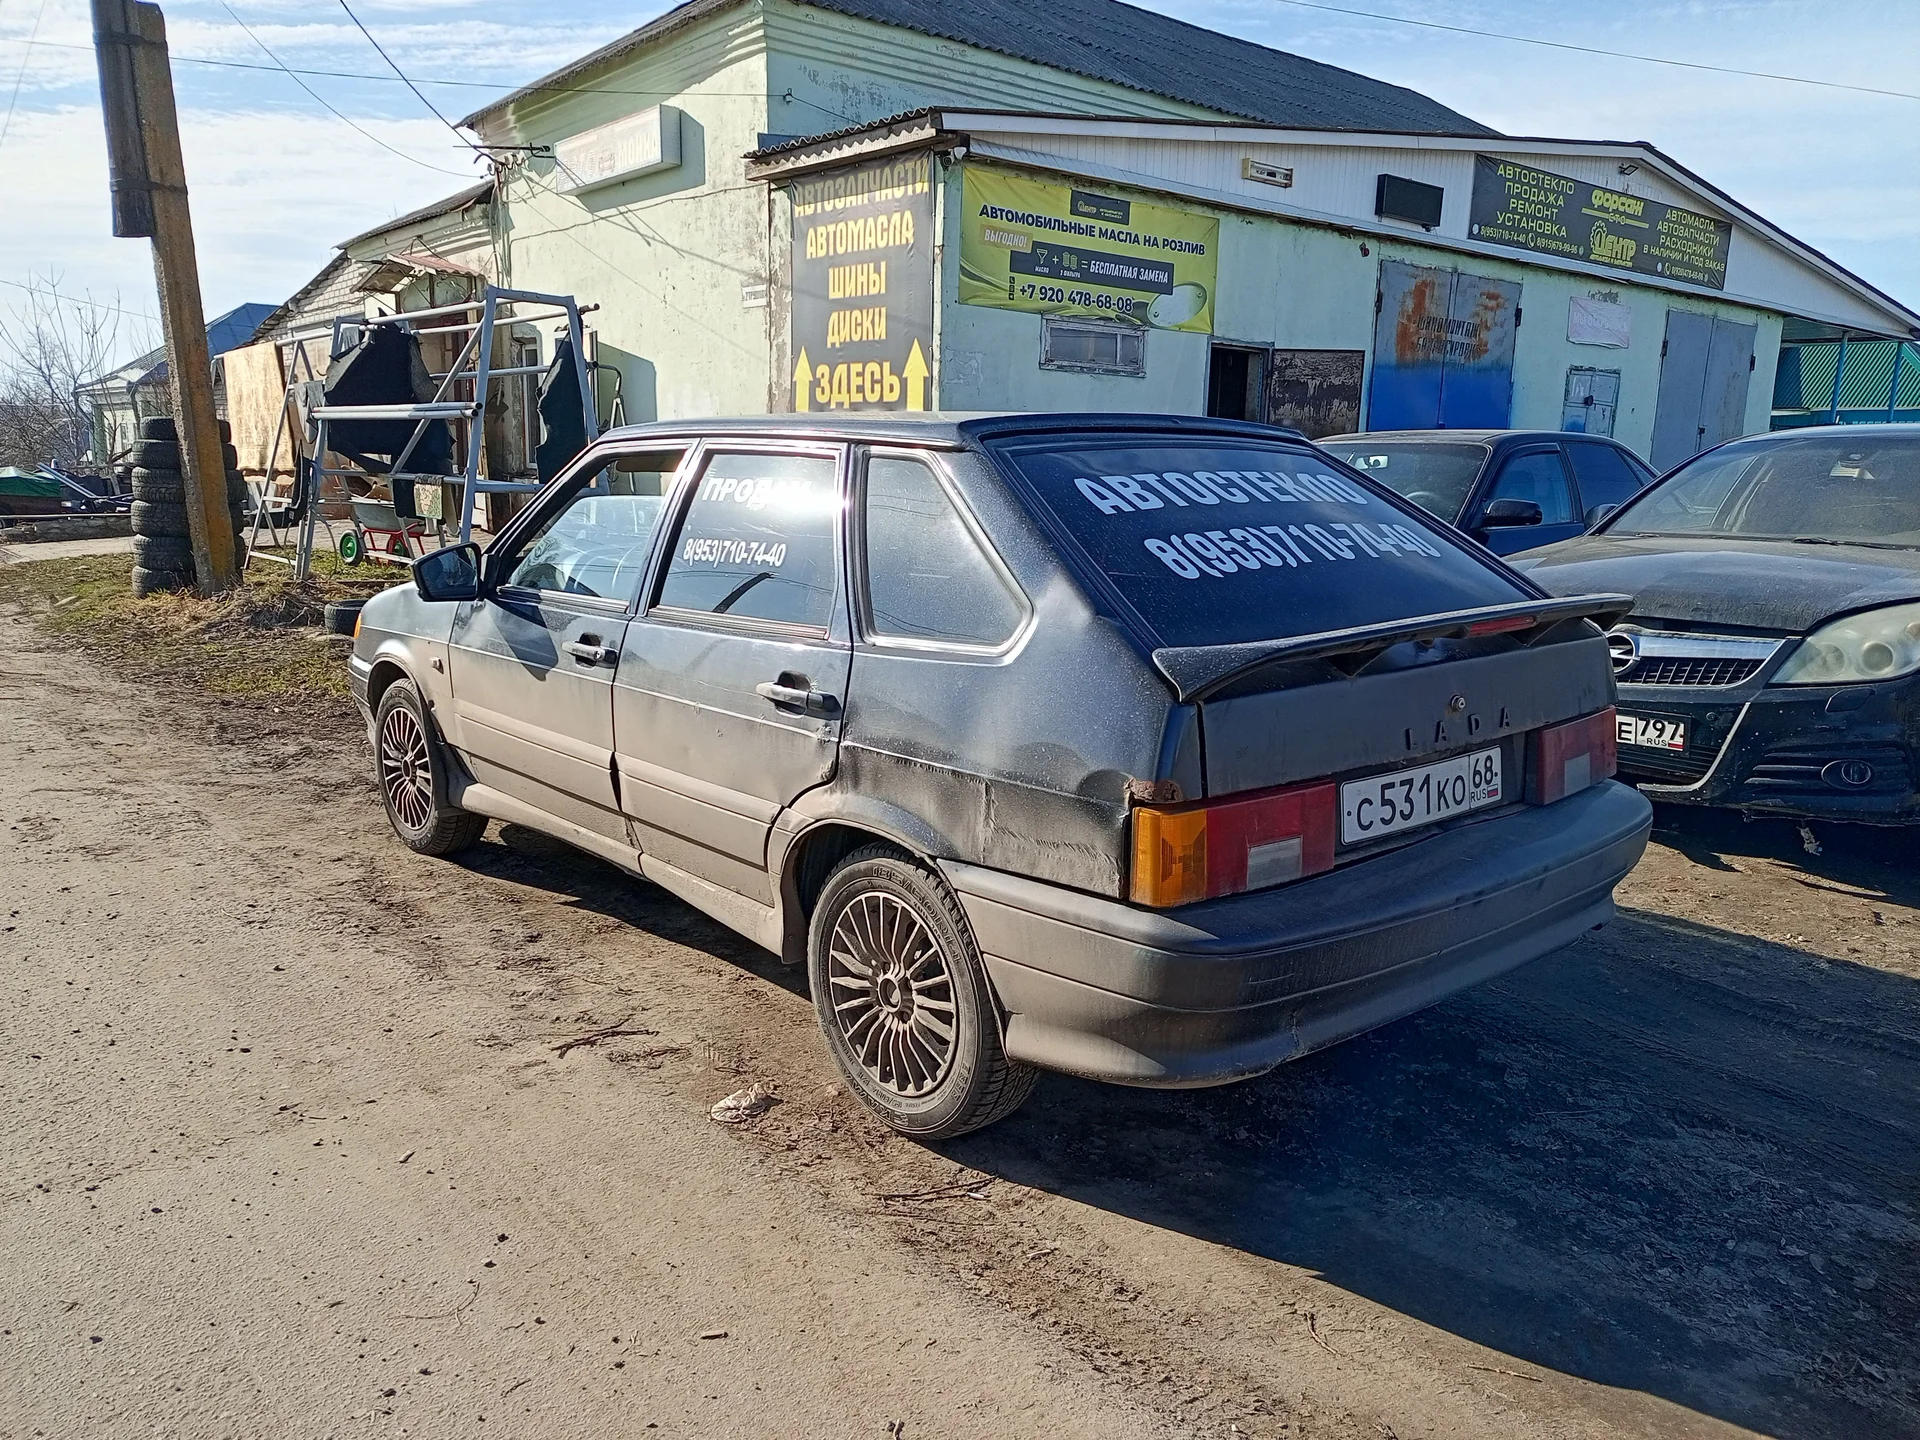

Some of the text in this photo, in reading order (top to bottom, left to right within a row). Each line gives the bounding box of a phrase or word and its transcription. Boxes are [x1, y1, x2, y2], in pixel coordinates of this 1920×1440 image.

[794, 158, 930, 218] АВТОЗАПЧАСТИ
[1497, 164, 1575, 194] АВТОСТЕКЛО
[1505, 181, 1564, 208] ПРОДАЖА
[1510, 198, 1558, 220] РЕМОНТ
[806, 209, 915, 260] АВТОМАСЛА
[979, 204, 1096, 237] АВТОМОБИЛЬНЫЕ
[1098, 226, 1140, 245] МАСЛА
[1143, 235, 1160, 249] НА
[1162, 240, 1206, 256] РОЗЛИВ
[1496, 210, 1567, 238] УСТАНОВКА
[1656, 220, 1720, 247] АВТОЗАПЧАСТИ
[1665, 209, 1715, 232] АВТОМАСЛА
[984, 228, 1027, 248] ВЫГОДНО!
[1592, 228, 1637, 261] ЦЕНТР
[1659, 235, 1714, 258] РАСХОДНИКИ
[1089, 260, 1169, 284] БЕСПЛАТНАЯ ЗАМЕНА
[1643, 244, 1725, 272] В НАЛИЧИИ И ПОД ЗАКАЗ
[828, 261, 887, 300] ШИНЫ
[1020, 284, 1133, 313] +7 920 478-68-08
[826, 306, 887, 348] ДИСКИ
[815, 360, 901, 409] ЗДЕСЬ
[1073, 470, 1368, 515] АВТОСТЕКЛО
[683, 538, 787, 568] 8(953)710-74-40
[1144, 522, 1442, 580] 8(953)710-74-40
[1404, 706, 1510, 750] LADA
[1637, 717, 1681, 741] 797
[1646, 737, 1668, 747] RUS
[1472, 755, 1494, 788] 68
[1471, 790, 1487, 803] RUS
